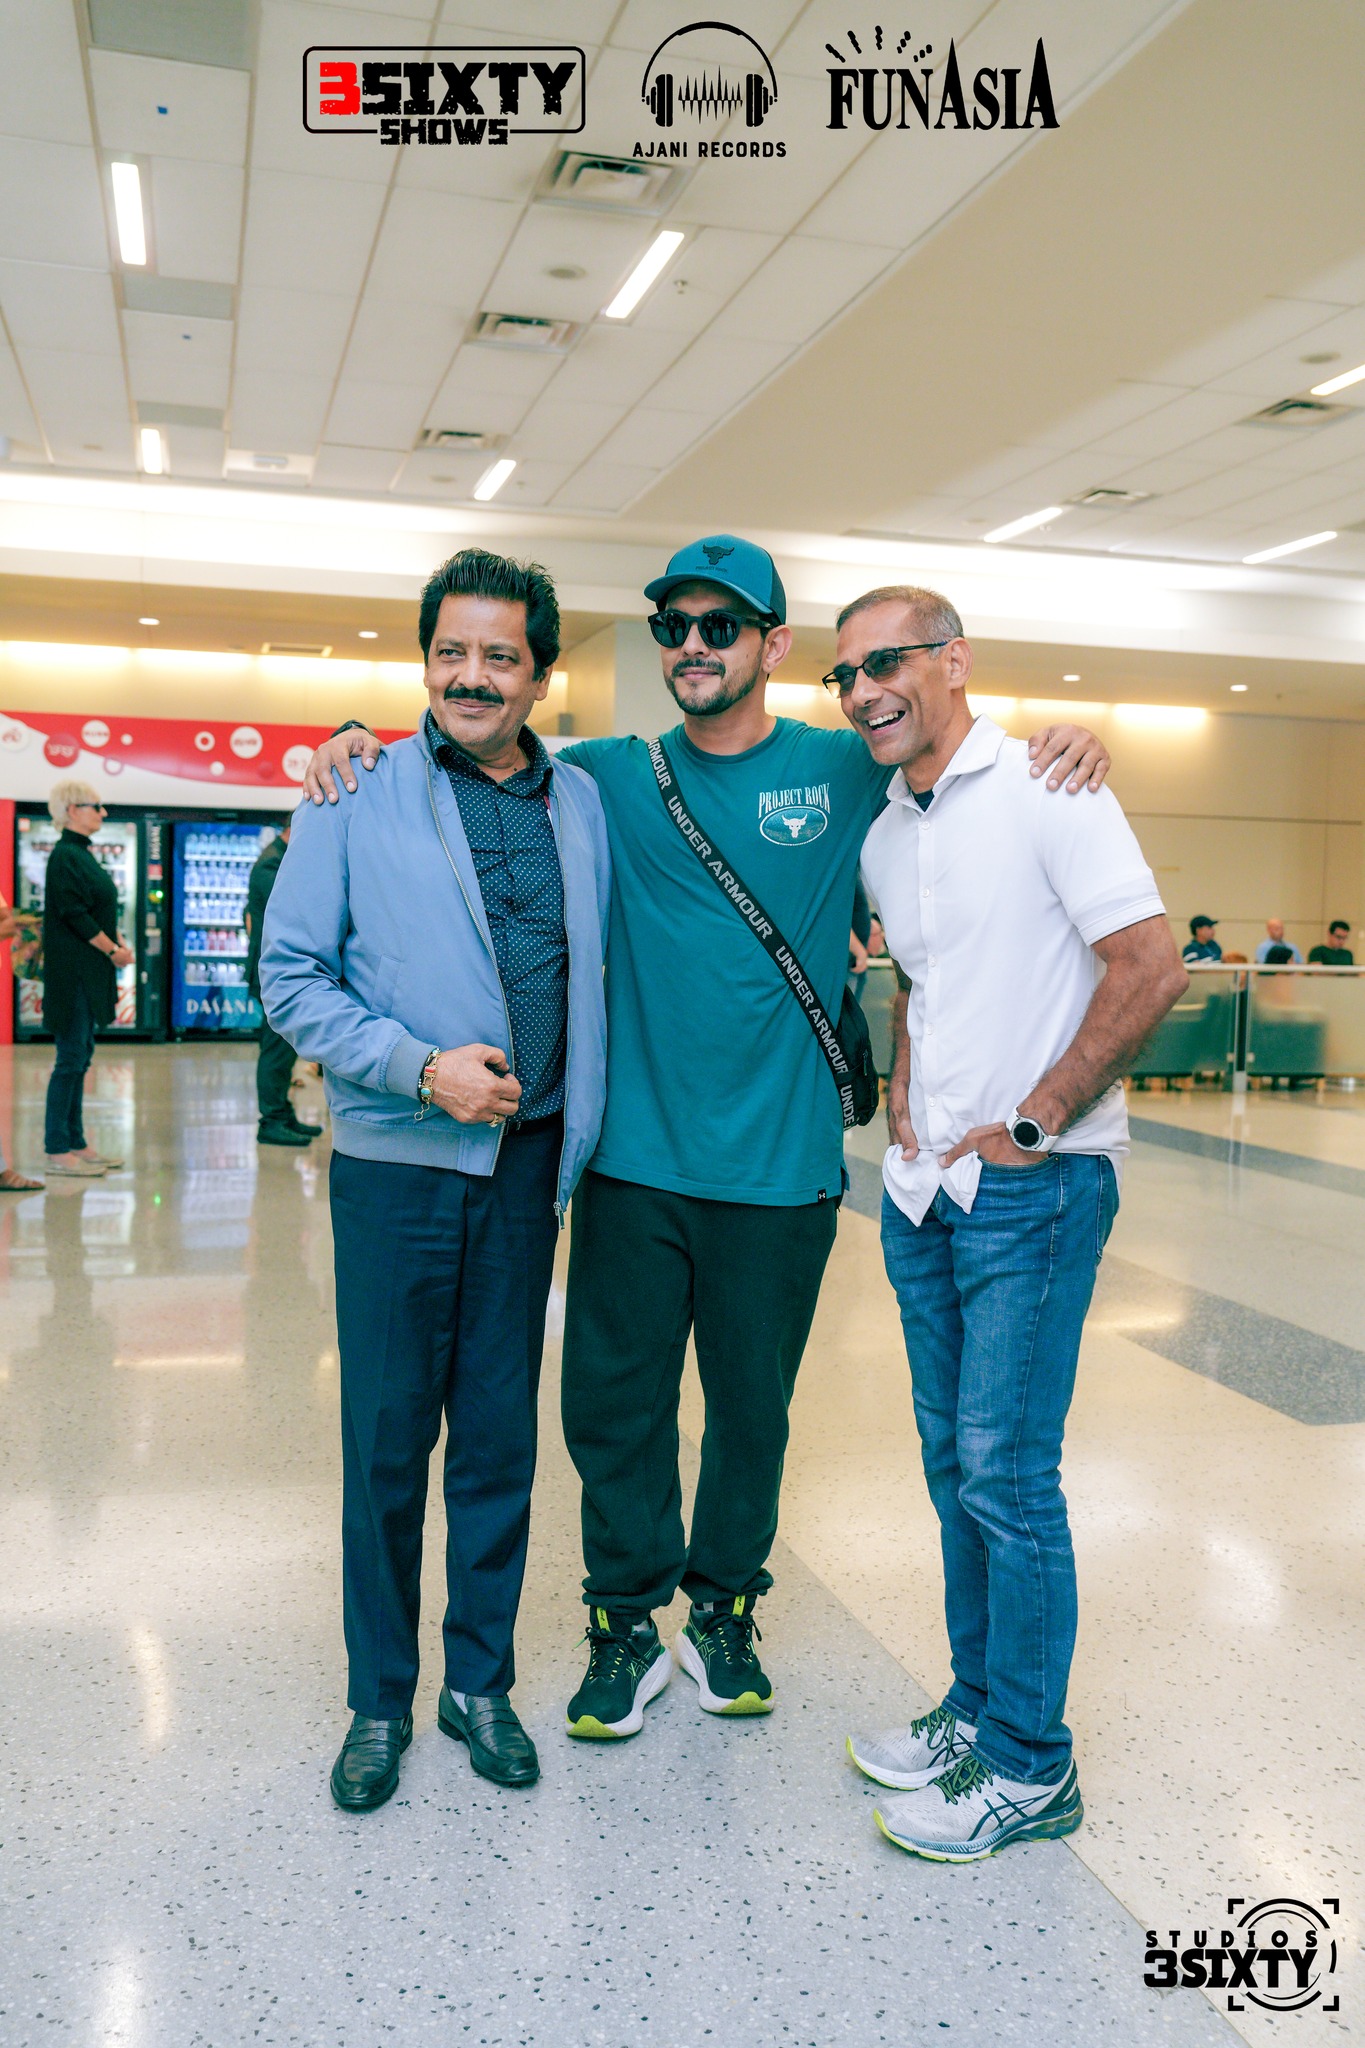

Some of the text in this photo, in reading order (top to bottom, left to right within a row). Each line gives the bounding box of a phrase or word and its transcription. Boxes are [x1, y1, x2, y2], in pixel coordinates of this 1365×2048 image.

[758, 782, 831, 819] PROJECT ROCK
[668, 795, 773, 940] UNDER ARMOUR
[186, 998, 254, 1016] DASANI
[775, 945, 849, 1074] UNDER ARMOUR
[840, 1084, 855, 1129] UNDE
